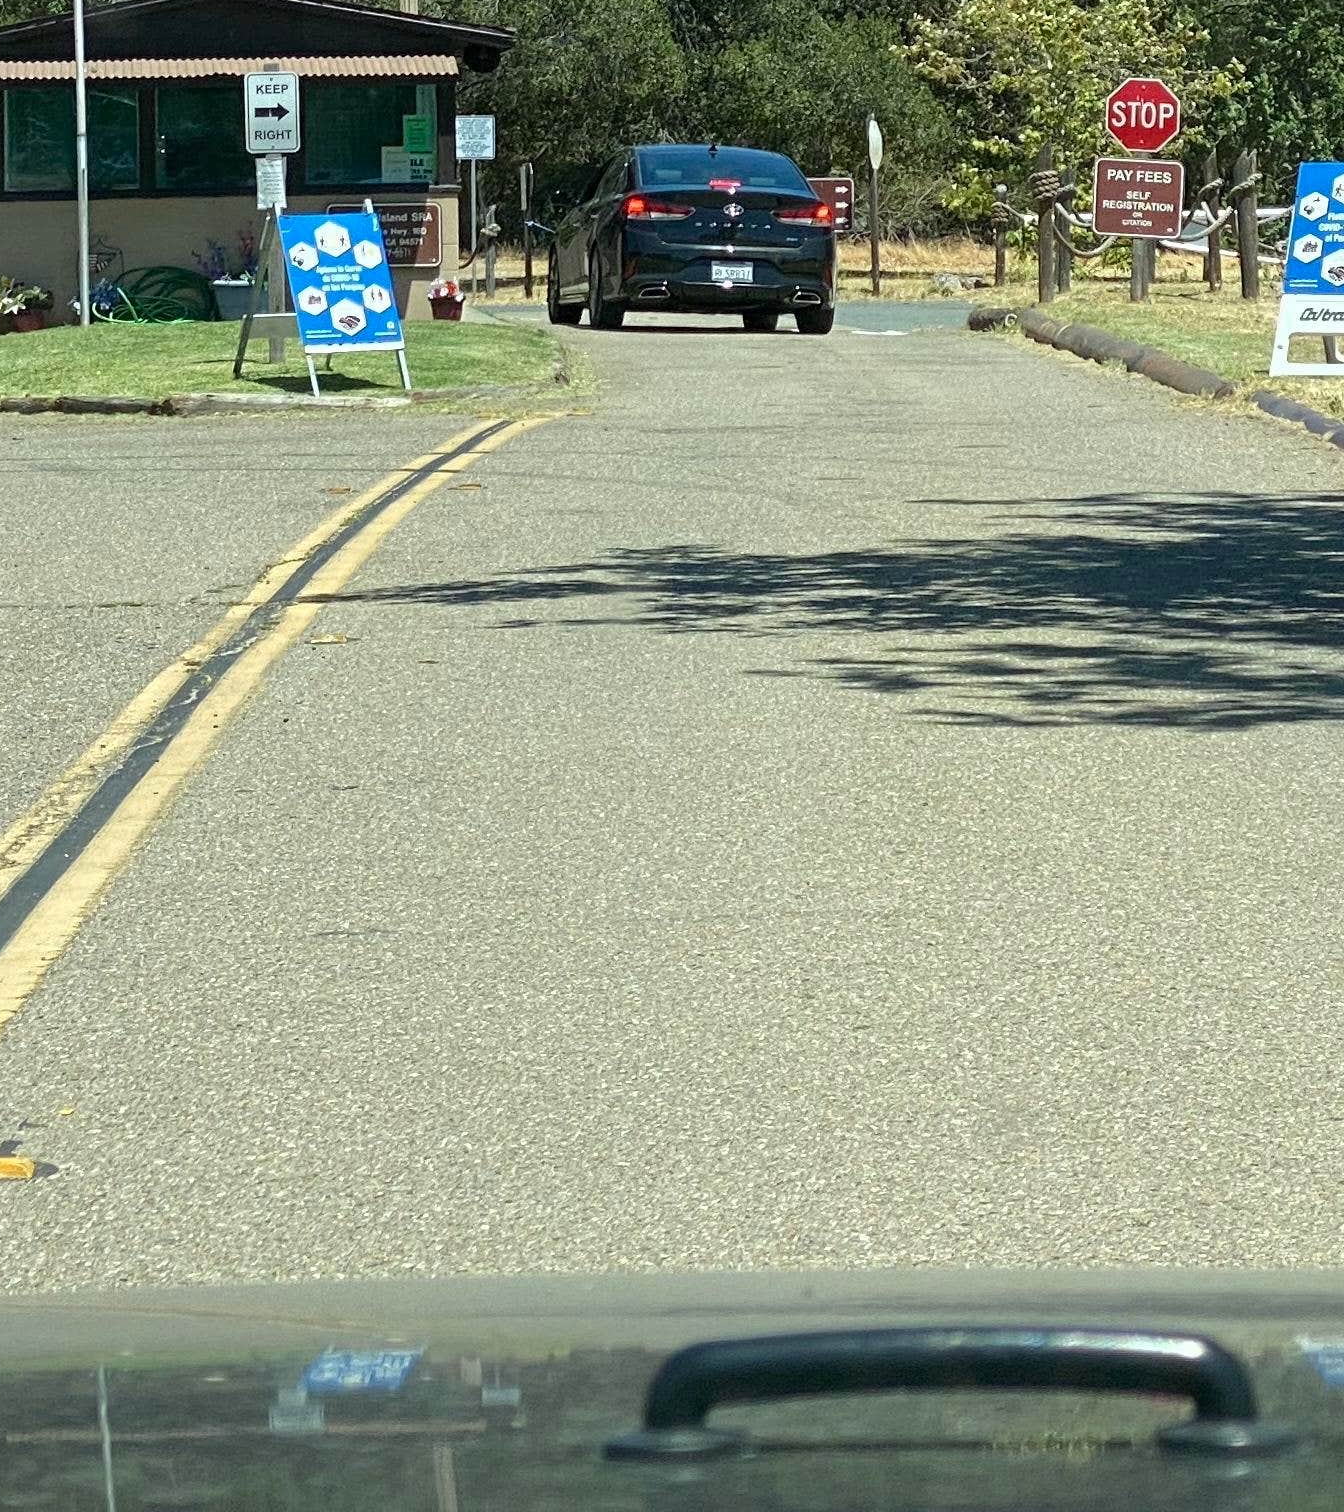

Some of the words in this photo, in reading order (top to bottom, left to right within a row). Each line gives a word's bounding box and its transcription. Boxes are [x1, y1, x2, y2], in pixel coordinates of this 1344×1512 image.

[256, 84, 289, 94] KEEP
[1111, 100, 1175, 129] STOP
[255, 130, 292, 140] RIGHT
[1107, 169, 1133, 182] PAY
[1136, 170, 1172, 184] FEES
[1126, 191, 1152, 200] SELF
[1102, 200, 1174, 212] REGISTRATION
[411, 212, 432, 222] SRA
[1122, 219, 1152, 227] CITATION
